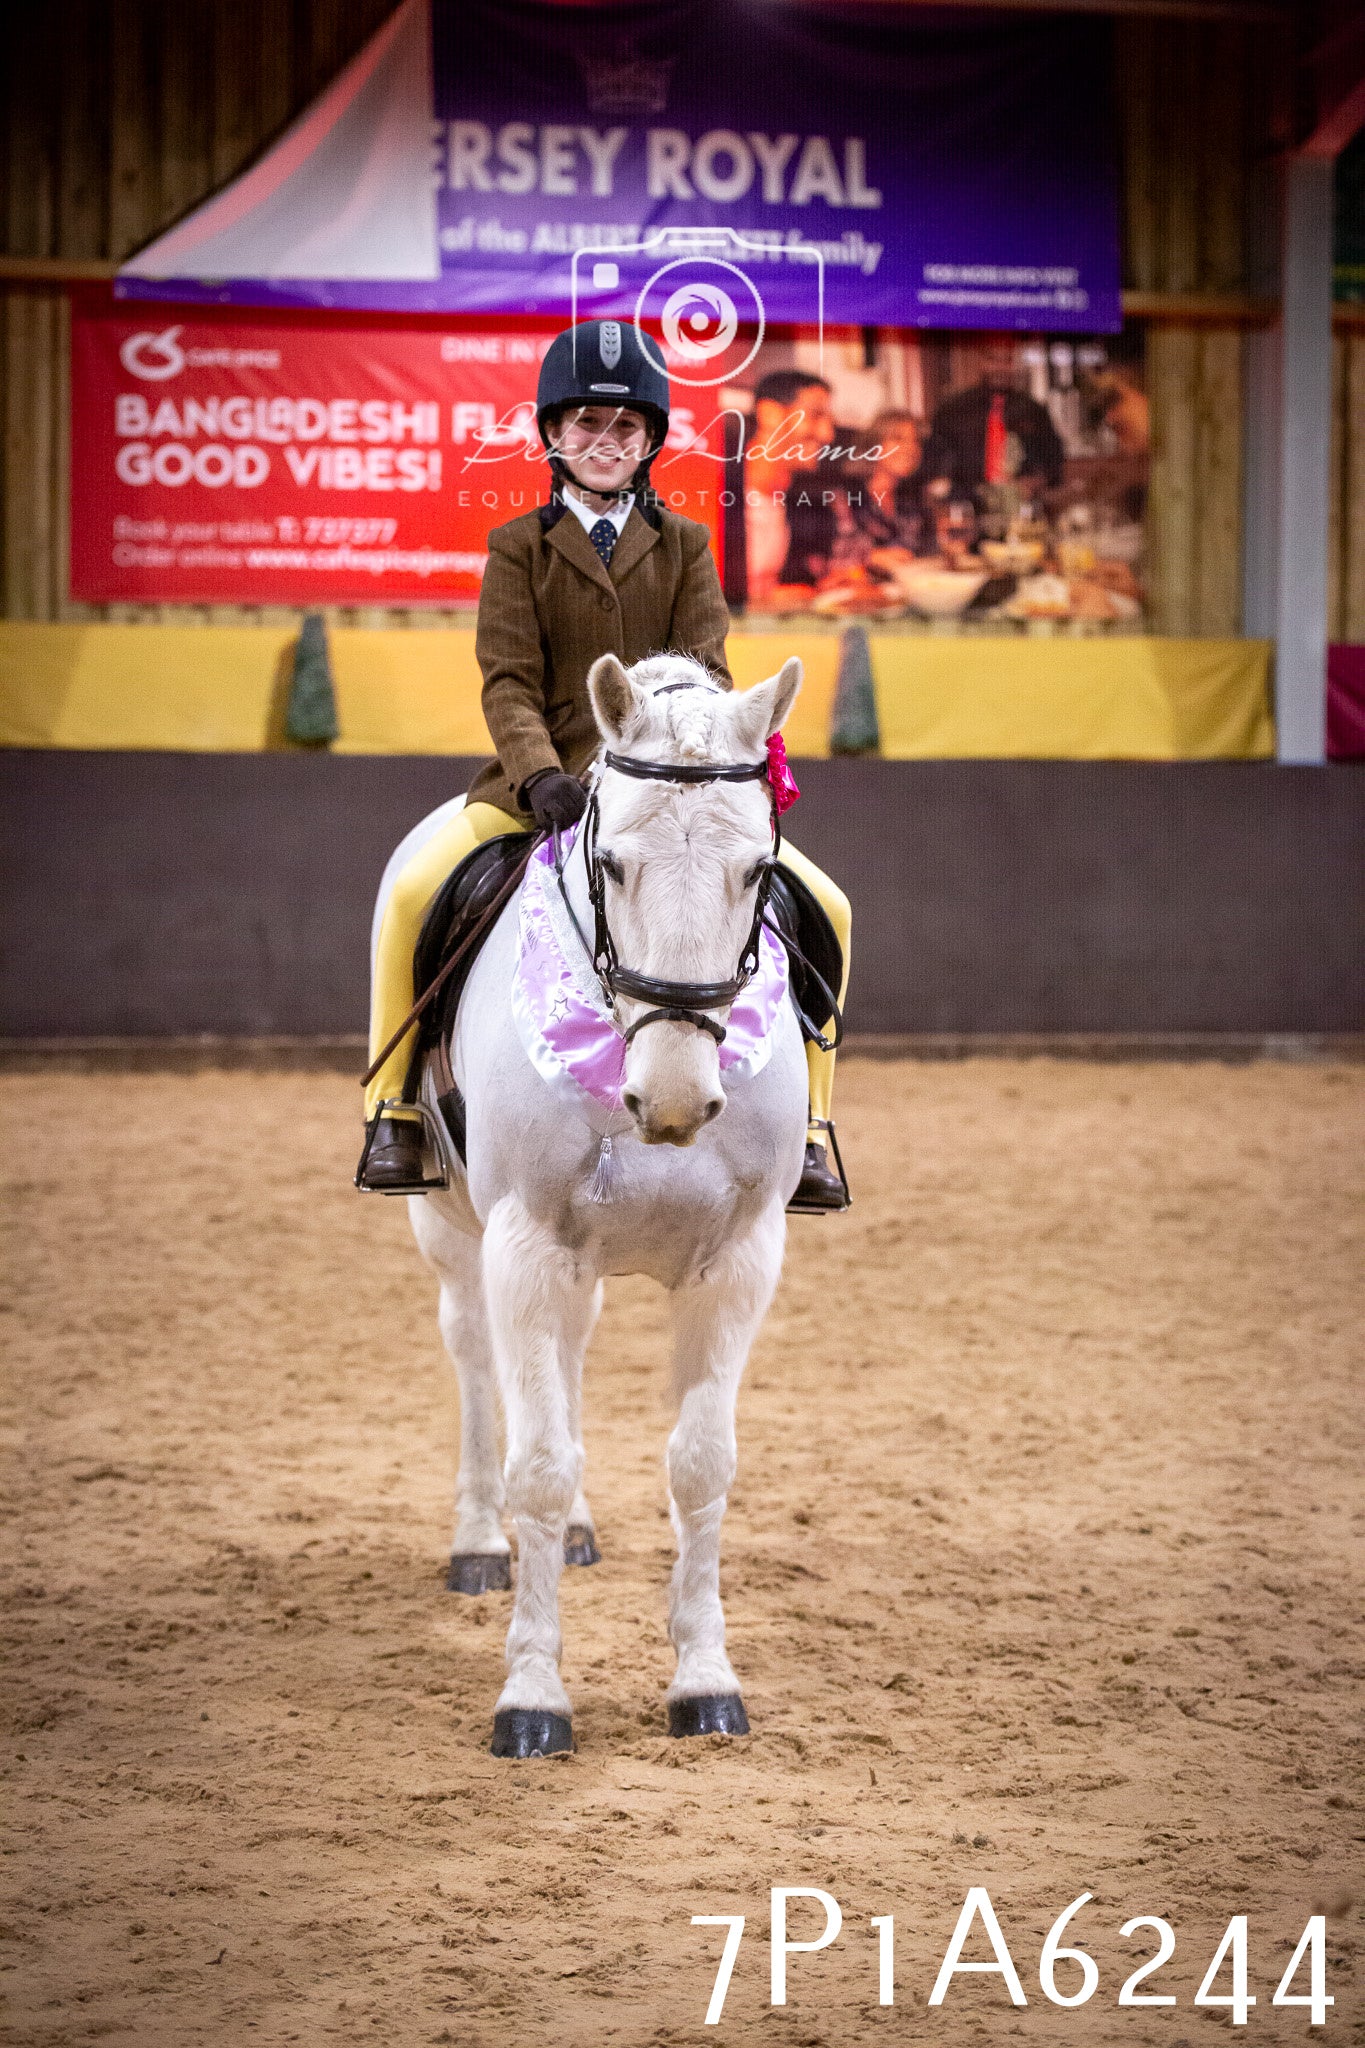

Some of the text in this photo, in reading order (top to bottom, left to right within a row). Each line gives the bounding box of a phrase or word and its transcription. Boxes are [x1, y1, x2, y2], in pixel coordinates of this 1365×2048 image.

[646, 128, 883, 209] ROYAL
[115, 442, 442, 492] GOOD VIBES!
